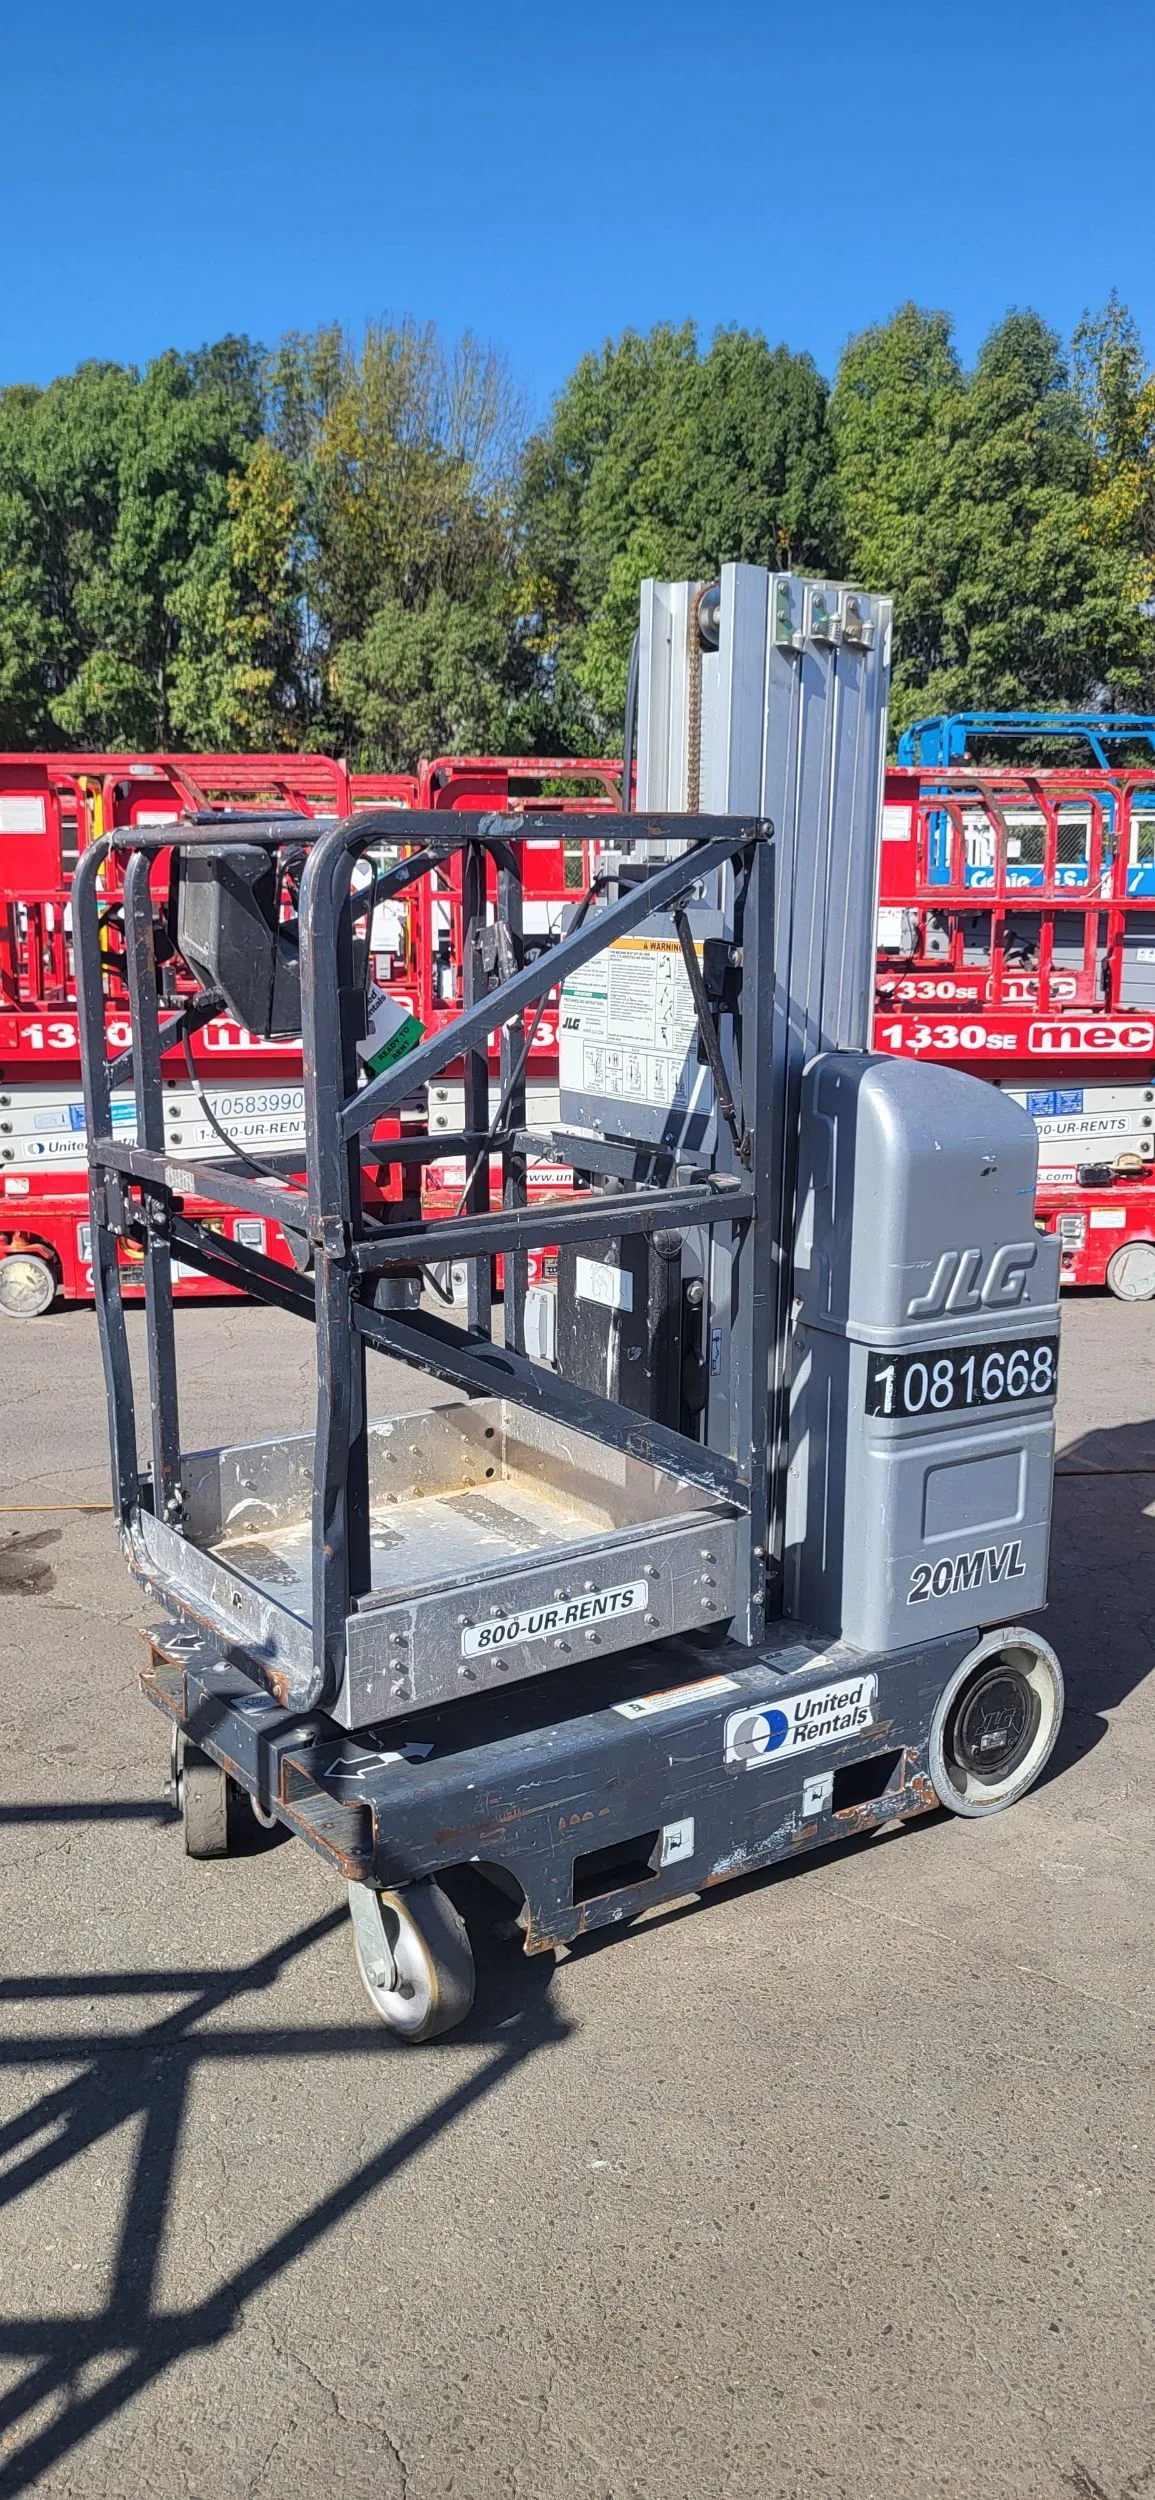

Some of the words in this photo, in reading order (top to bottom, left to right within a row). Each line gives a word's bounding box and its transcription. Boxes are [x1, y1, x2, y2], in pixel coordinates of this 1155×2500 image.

[563, 1017, 581, 1030] JLG
[881, 1025, 1018, 1050] 1330SE
[1031, 1026, 1151, 1049] mec
[378, 1038, 399, 1061] READY
[399, 1027, 409, 1038] TO
[211, 1092, 303, 1116] 10583990
[48, 1140, 88, 1153] Unite
[907, 1241, 1038, 1319] JLG
[874, 1346, 1054, 1414] 1081668
[906, 1540, 1027, 1605] 20MVL
[478, 1589, 635, 1648] 800-UR-RENTS
[795, 1685, 863, 1720] United
[792, 1706, 868, 1745] Rentals
